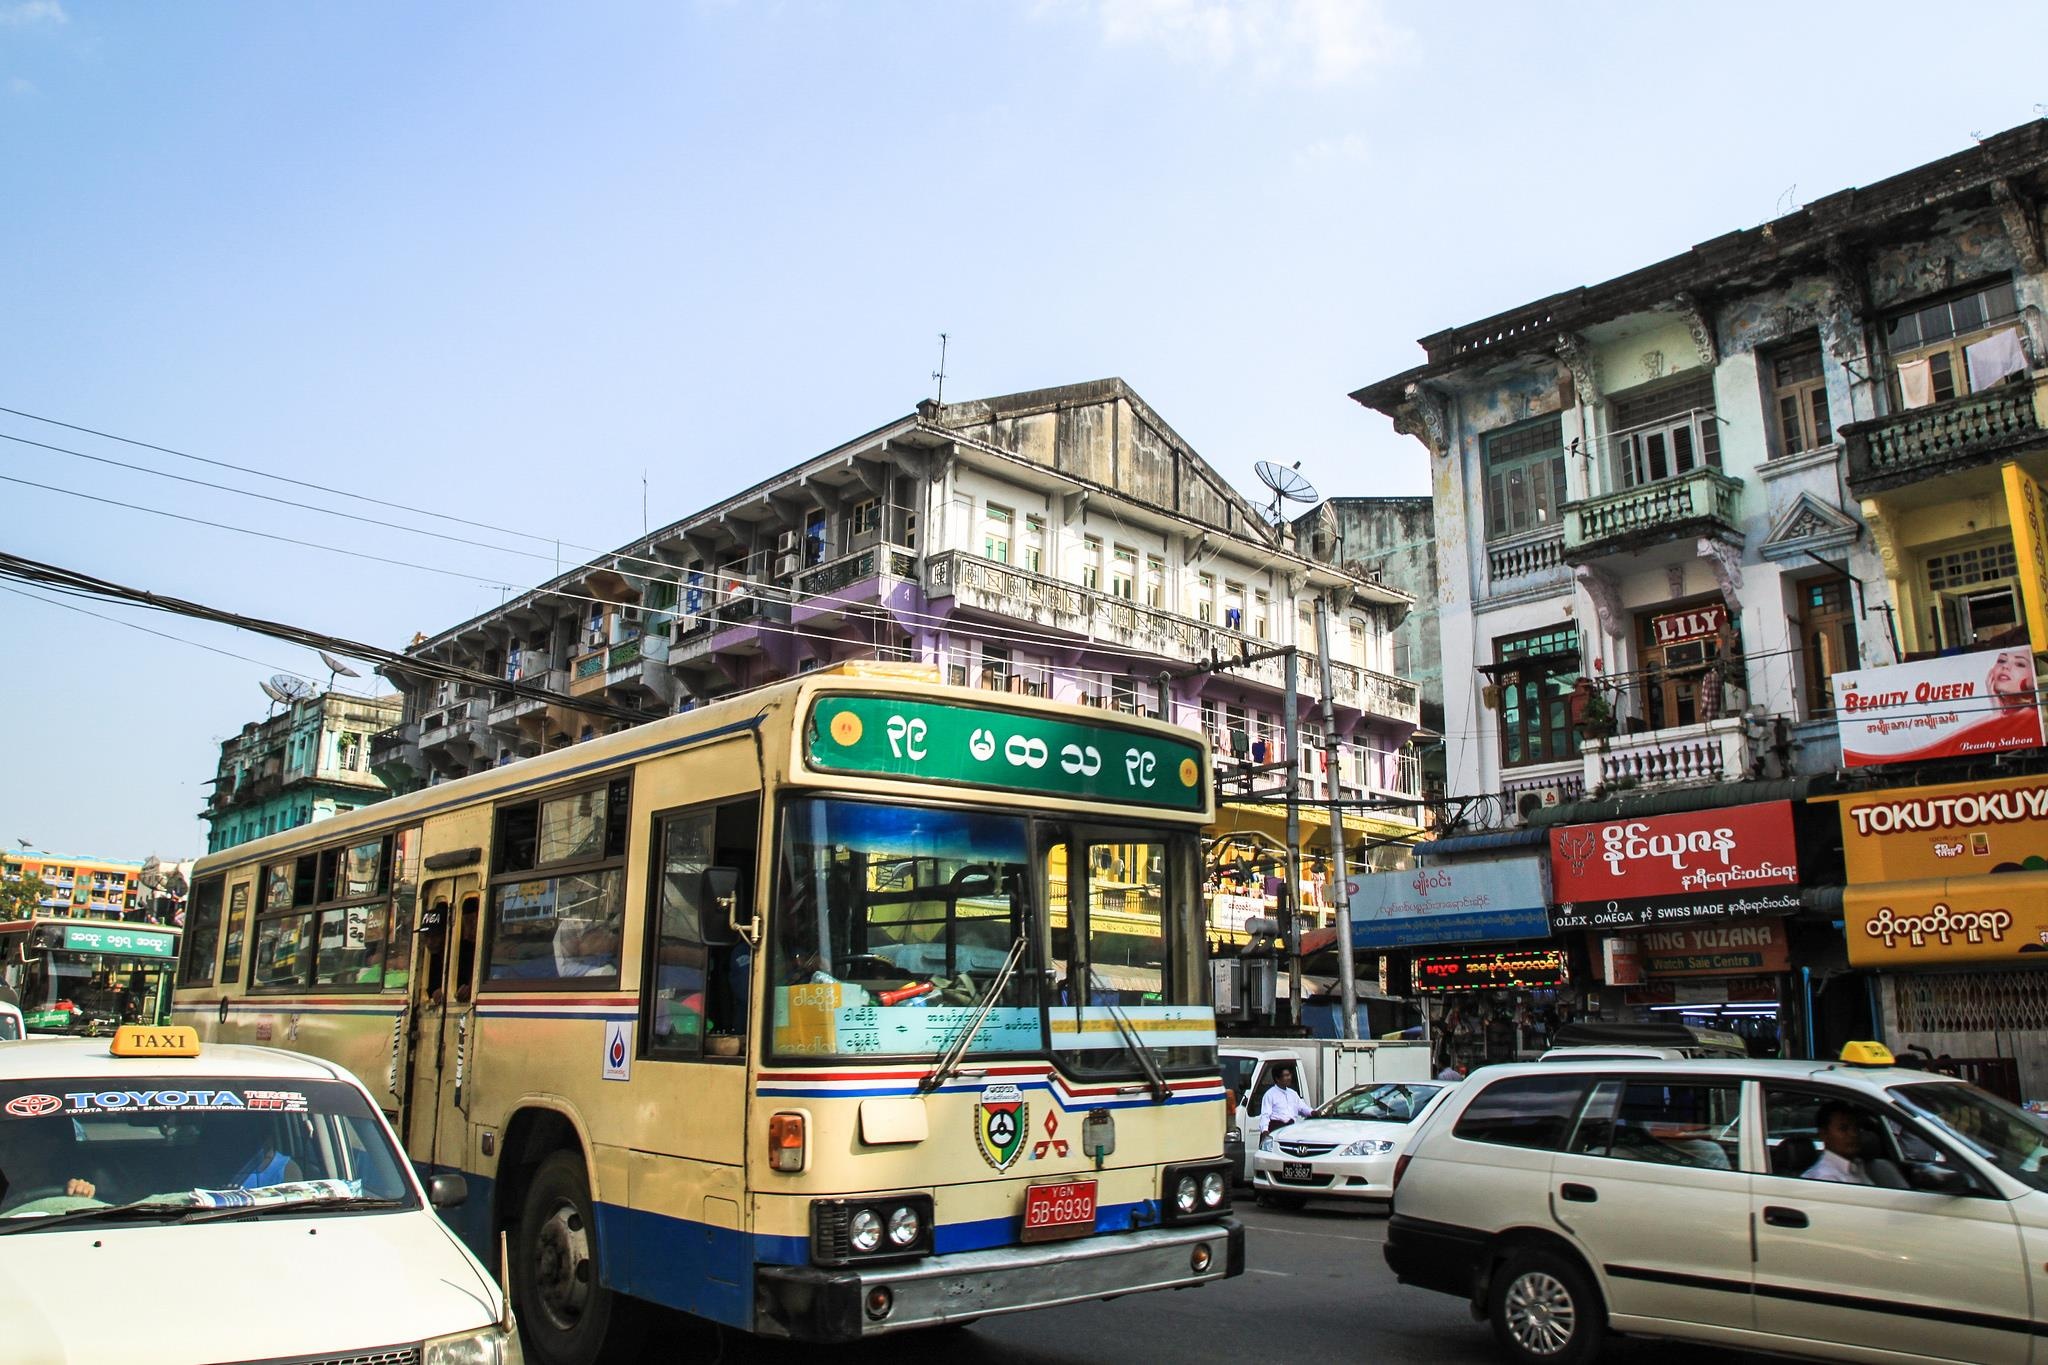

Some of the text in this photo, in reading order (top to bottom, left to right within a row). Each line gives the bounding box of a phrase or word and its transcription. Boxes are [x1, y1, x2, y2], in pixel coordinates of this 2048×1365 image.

[1658, 610, 1718, 640] LILY
[1844, 682, 1974, 713] BEAUTY QUEEN
[887, 715, 927, 761] ၃၉
[1125, 748, 1157, 788] ၃၉
[1960, 741, 1996, 751] Beauty
[1850, 788, 2048, 834] TOKUTOKUY
[1681, 861, 1797, 890] နာရီရောင်းဝယ်ရေး
[1595, 911, 1633, 924] OMEGA
[1657, 907, 1690, 919] SWISS
[1693, 904, 1724, 915] MADE
[1692, 926, 1773, 950] YUZANA
[1427, 964, 1459, 976] MYO
[1652, 955, 1750, 970] Watch Sale Centre
[132, 1033, 186, 1048] TAXI
[65, 1090, 245, 1109] TOYOTA
[1052, 1186, 1074, 1197] YGN
[1031, 1197, 1092, 1224] 5B-6939
